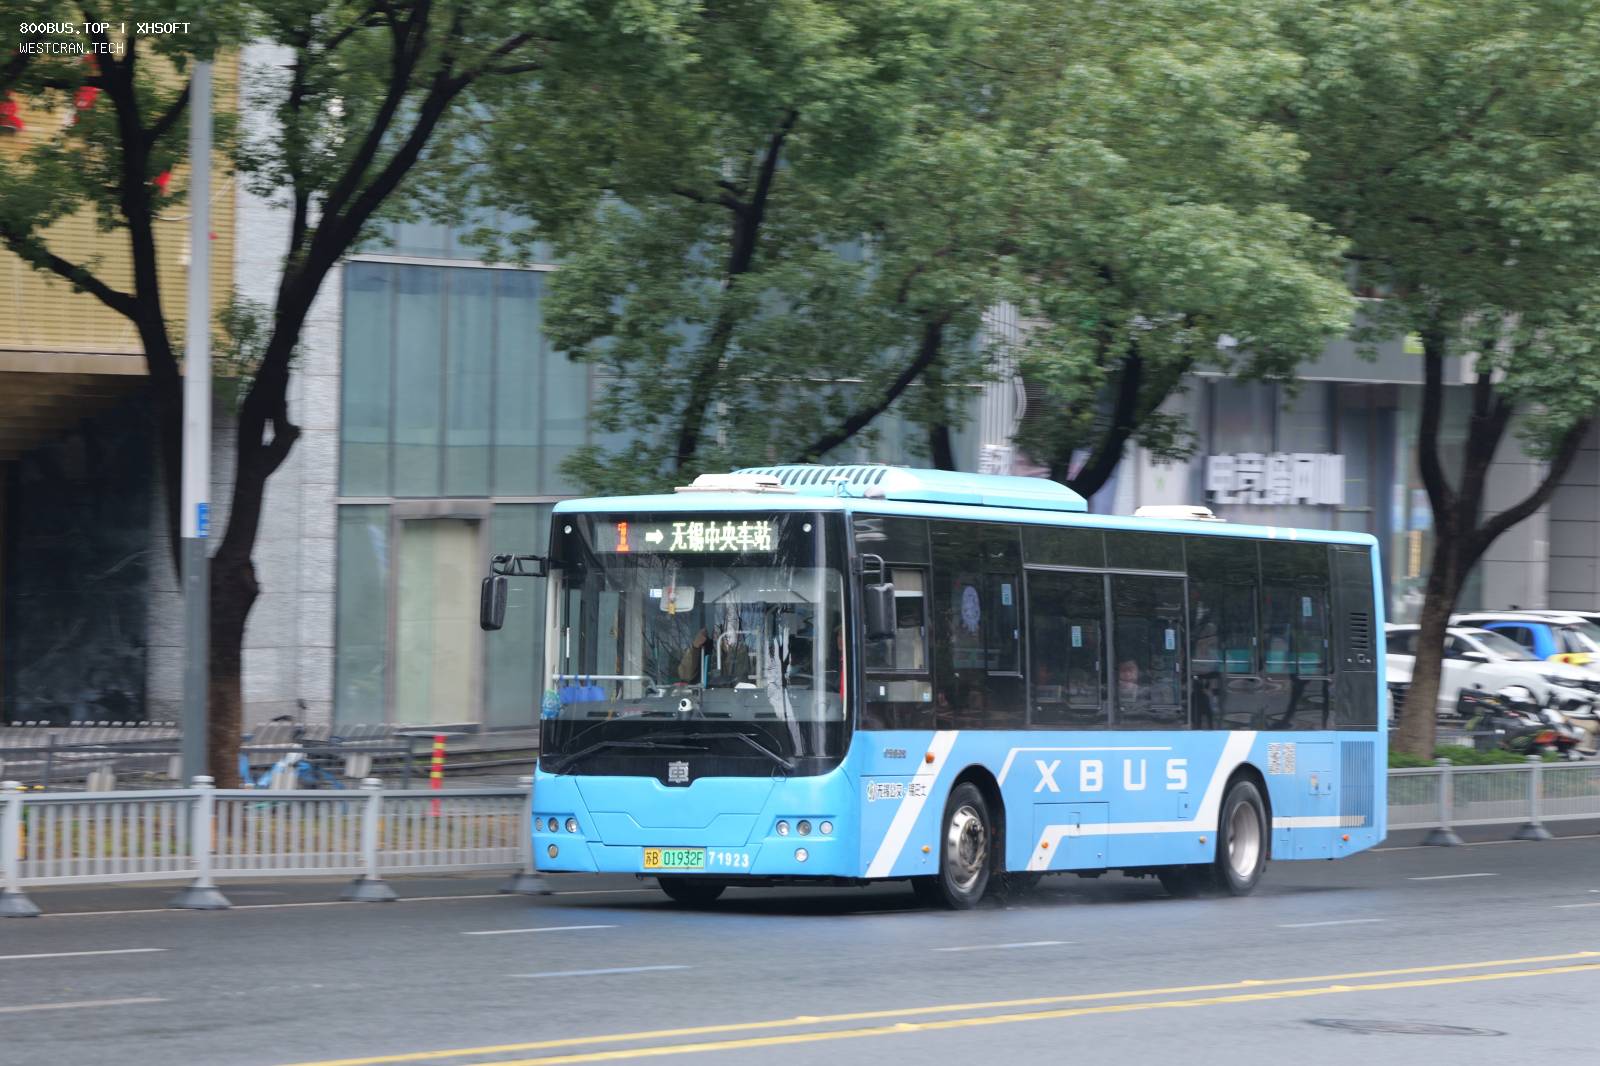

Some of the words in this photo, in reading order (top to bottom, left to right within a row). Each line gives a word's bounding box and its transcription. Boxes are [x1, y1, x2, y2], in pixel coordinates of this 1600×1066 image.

[615, 521, 629, 553] 1
[669, 520, 771, 551] 无锡中央车站
[708, 850, 750, 867] 71923
